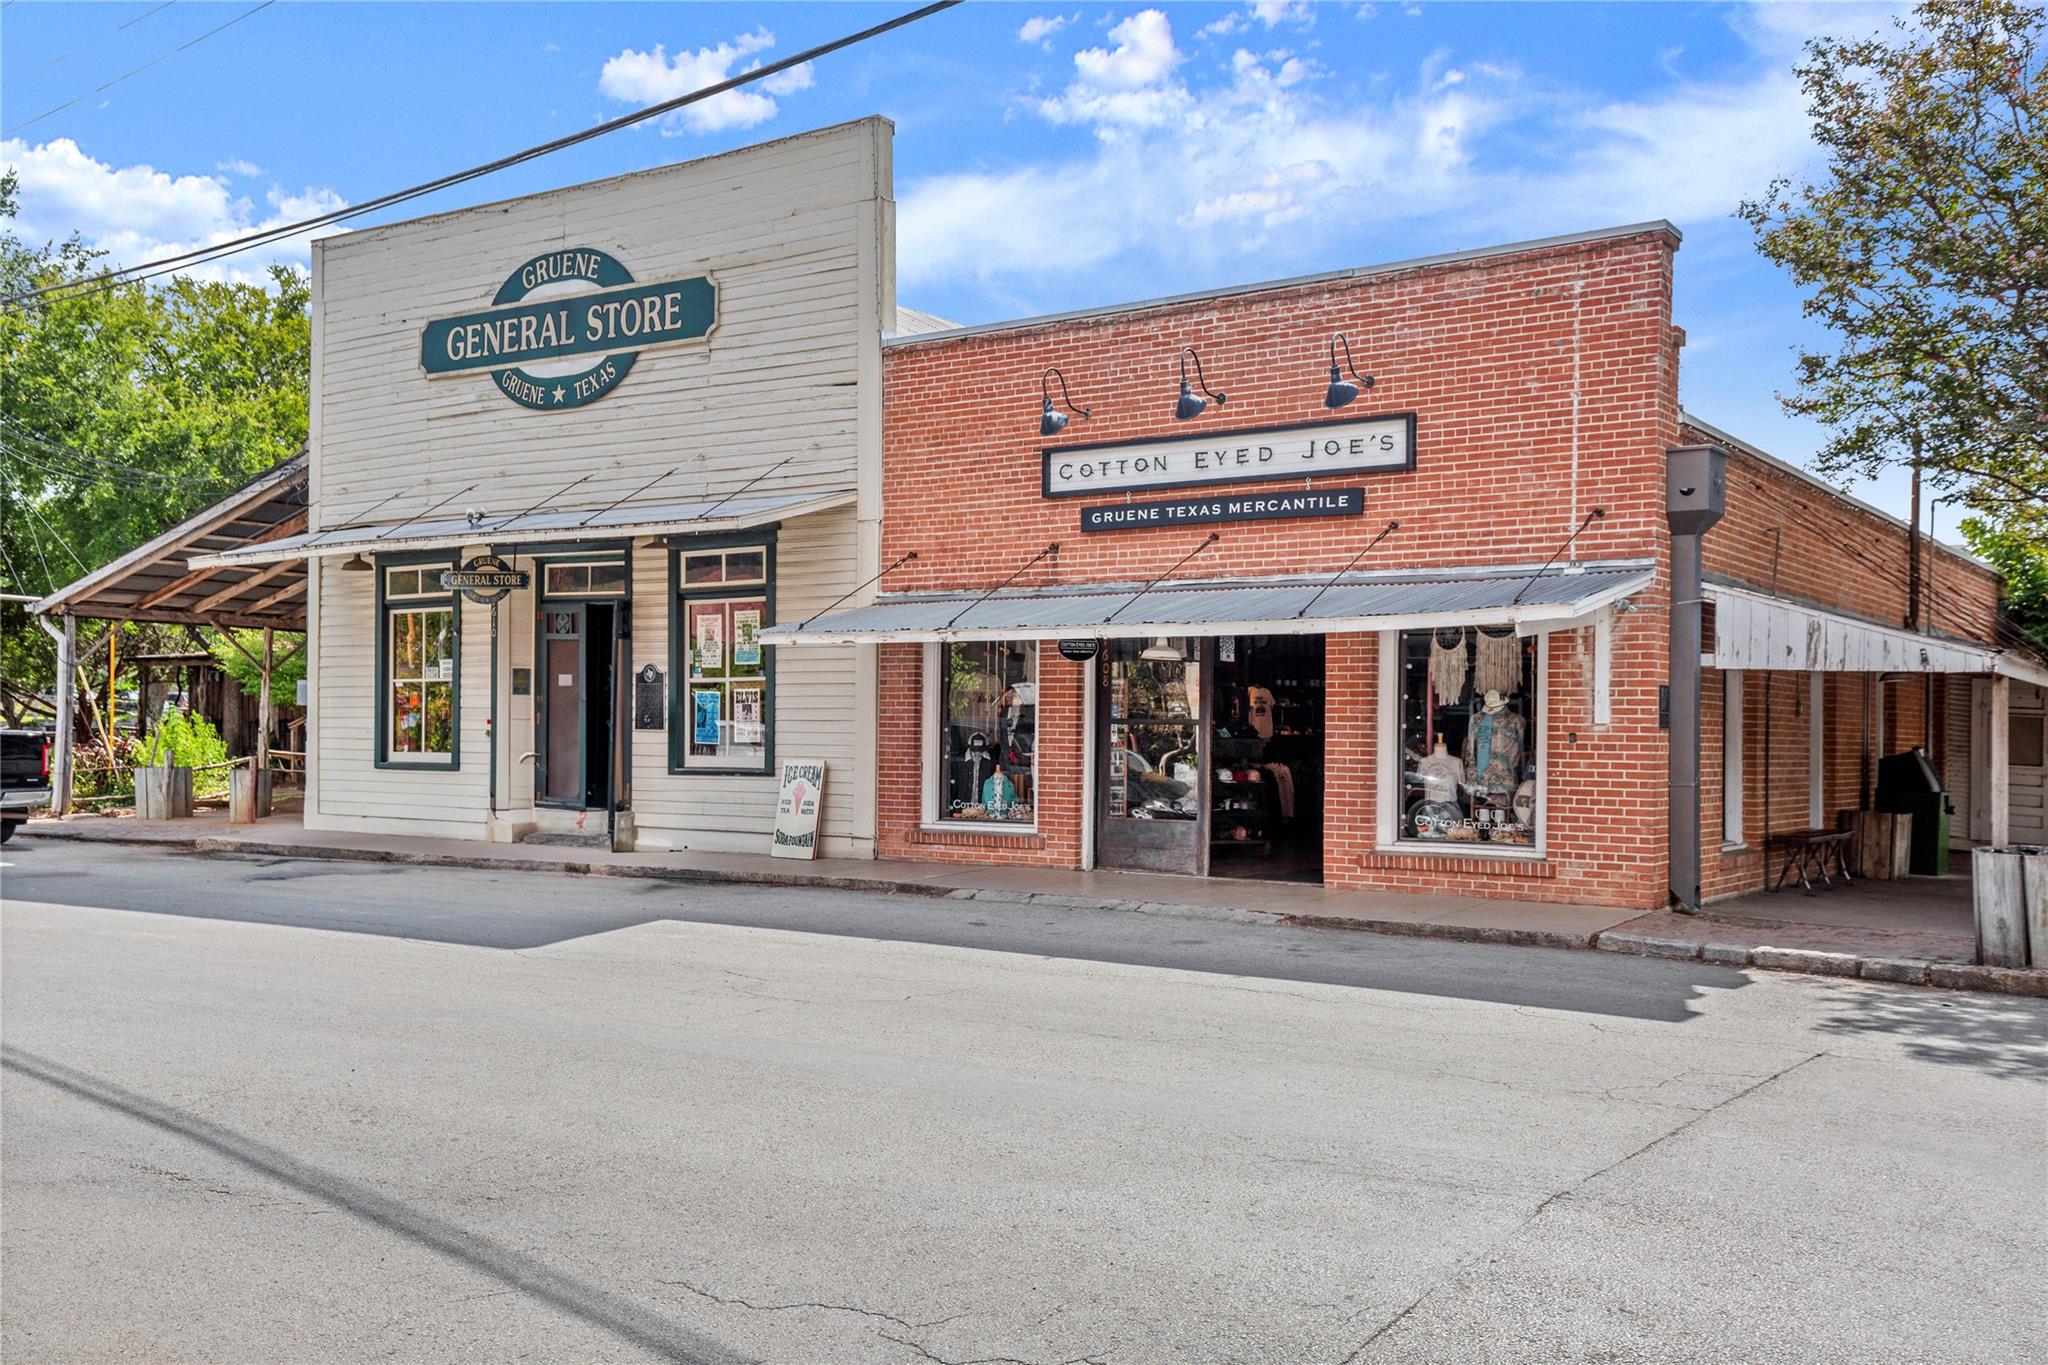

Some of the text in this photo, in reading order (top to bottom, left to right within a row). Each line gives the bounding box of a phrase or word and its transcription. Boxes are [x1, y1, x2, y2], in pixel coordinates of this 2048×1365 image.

[522, 253, 601, 289] GRUENE
[446, 292, 682, 361] GENERAL STORE
[502, 361, 617, 405] GRUENE TEXAS
[1058, 434, 1395, 480] COTTON EYED JOE'S
[1092, 495, 1349, 524] GRUENE TEXAS MERCANTILE
[473, 558, 500, 568] GRUENE
[450, 574, 522, 585] GENERAL STORE
[736, 691, 759, 704] ELVIS
[782, 765, 823, 791] ICE CREAM
[953, 799, 986, 809] COTTON
[1008, 800, 1031, 811] JOE'S
[1415, 815, 1525, 831] COTTON EYED JOE'S
[788, 830, 815, 848] FOUNTAIN
